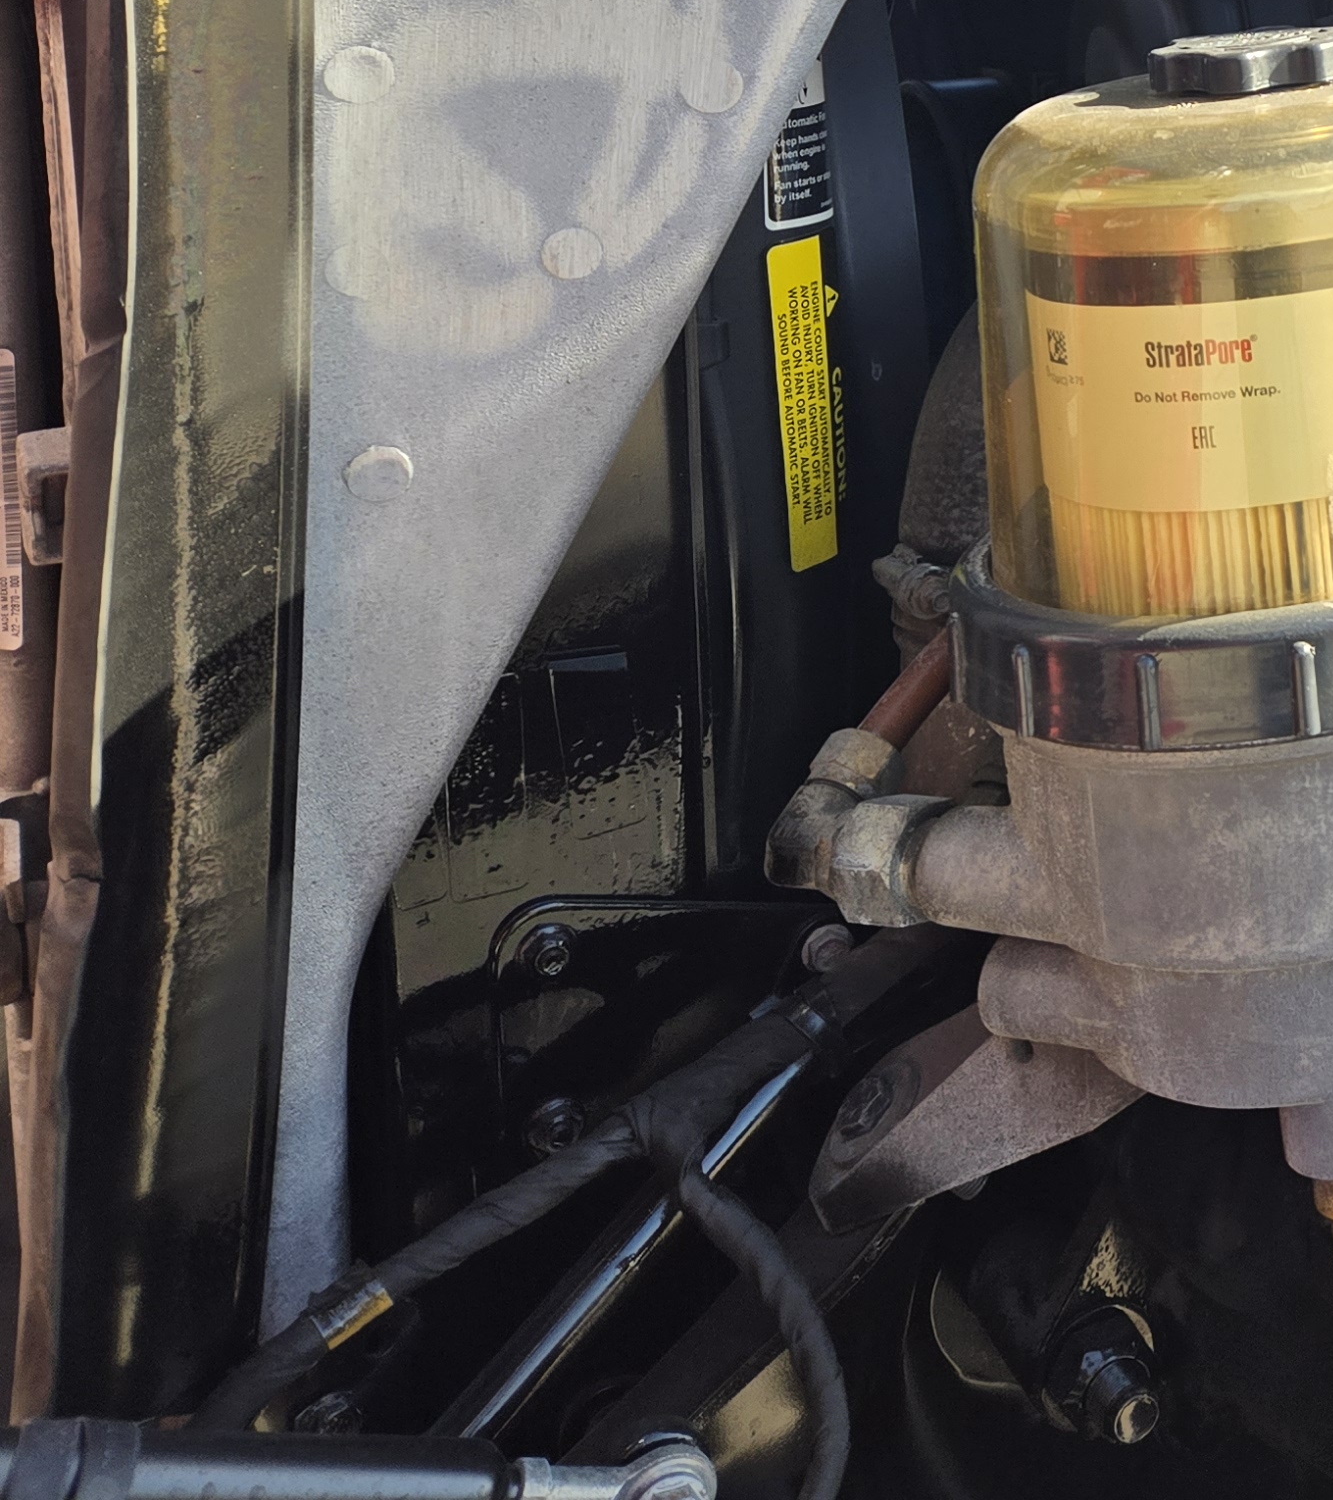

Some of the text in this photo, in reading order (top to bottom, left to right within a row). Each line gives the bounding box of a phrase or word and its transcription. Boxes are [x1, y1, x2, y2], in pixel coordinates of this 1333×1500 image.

[774, 180, 791, 191] Fan
[774, 194, 787, 205] by
[788, 286, 801, 346] WORKING
[800, 285, 811, 321] AVOID
[811, 281, 821, 325] ENGINE
[777, 313, 789, 356] SOUND
[814, 328, 824, 366] COULD
[793, 349, 803, 369] ON
[781, 359, 793, 402] BEFORE
[794, 372, 804, 396] FAN
[806, 369, 816, 401] TURN
[816, 369, 826, 401] START
[1134, 385, 1282, 404] Do Not Remove Wrap.
[796, 398, 805, 416] OR
[785, 405, 798, 471] AUTOMATIC
[808, 403, 819, 457] IGNITION
[832, 366, 846, 502] CAUTION:
[801, 457, 811, 496] ALARM
[811, 460, 821, 480] OFF
[803, 497, 813, 526] WILL
[813, 483, 823, 521] WHEN
[824, 500, 832, 516] TO
[1, 613, 9, 632] MADE
